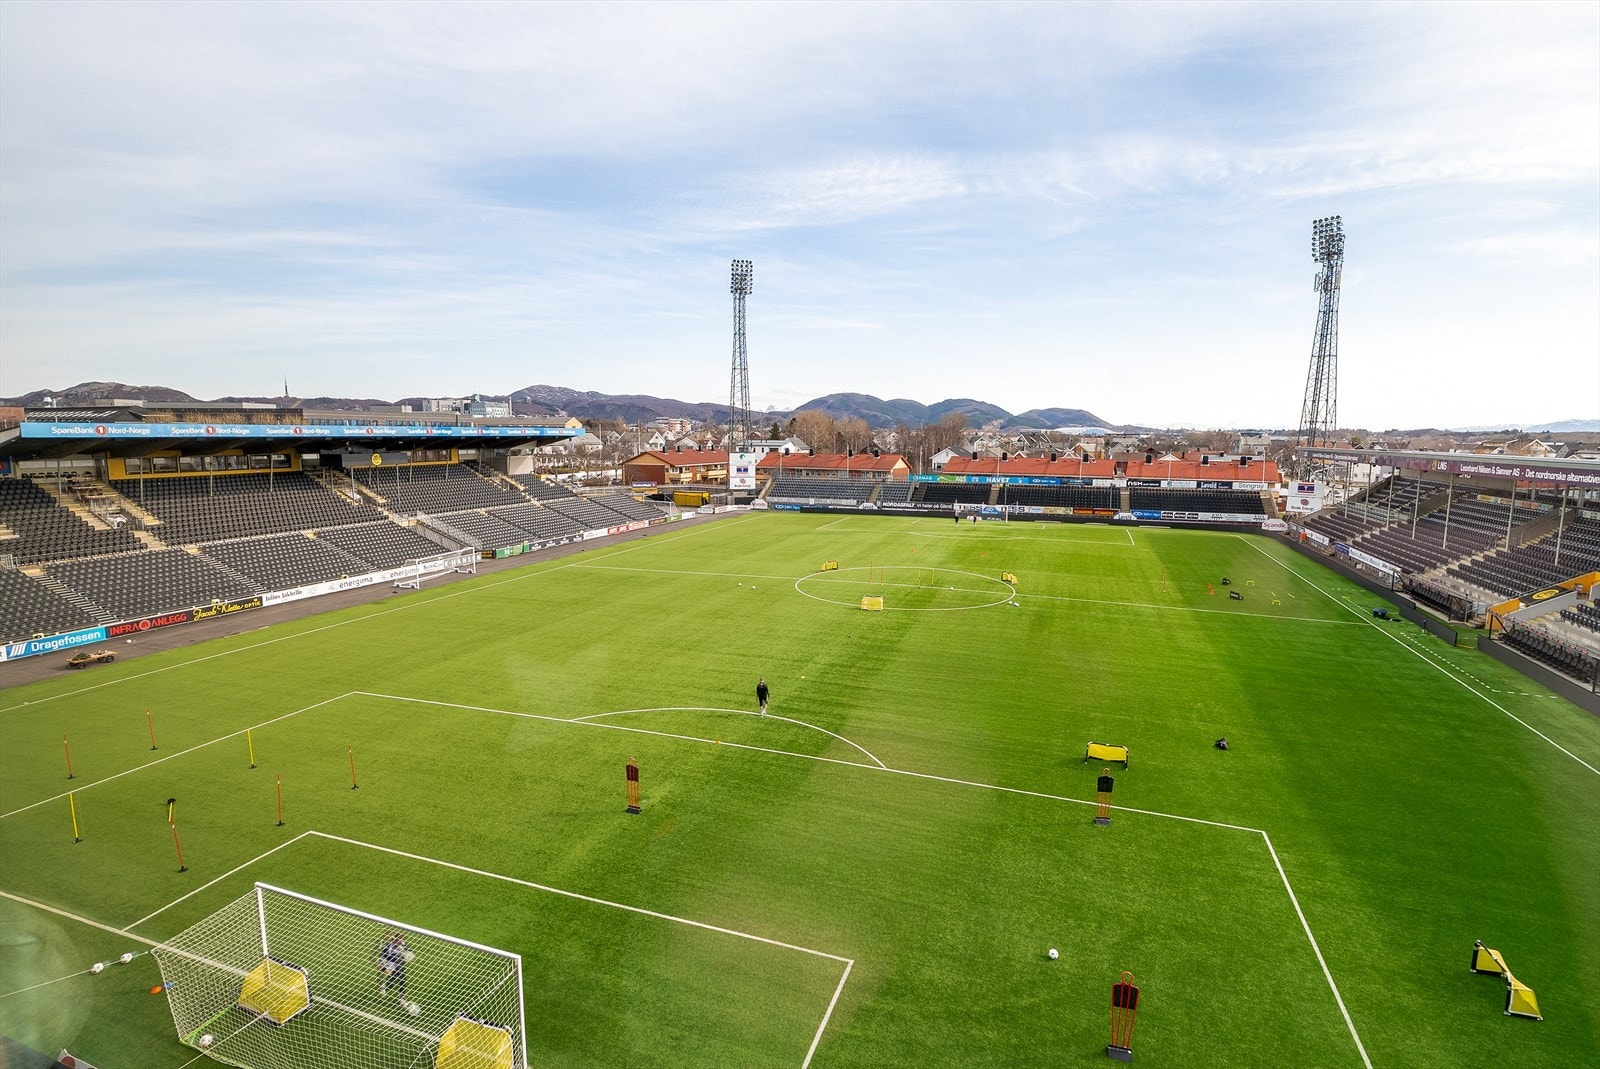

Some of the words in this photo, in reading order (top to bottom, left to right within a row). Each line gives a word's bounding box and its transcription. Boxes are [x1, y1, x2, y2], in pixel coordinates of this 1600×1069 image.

[51, 427, 95, 436] SpareBank
[97, 426, 106, 435] 1
[108, 427, 150, 437] Nord-Norge
[171, 427, 205, 436] SpareBank
[215, 427, 250, 436] Nord-Norge
[1437, 461, 1448, 471] LNS
[1512, 469, 1520, 477] AS
[1525, 469, 1536, 478] Det
[1535, 471, 1567, 481] nordnorske
[339, 576, 373, 589] energima
[193, 604, 217, 622] Jacob
[109, 624, 139, 636] INFRA
[150, 613, 187, 628] ANLEGG
[31, 631, 101, 652] Dragefossen
